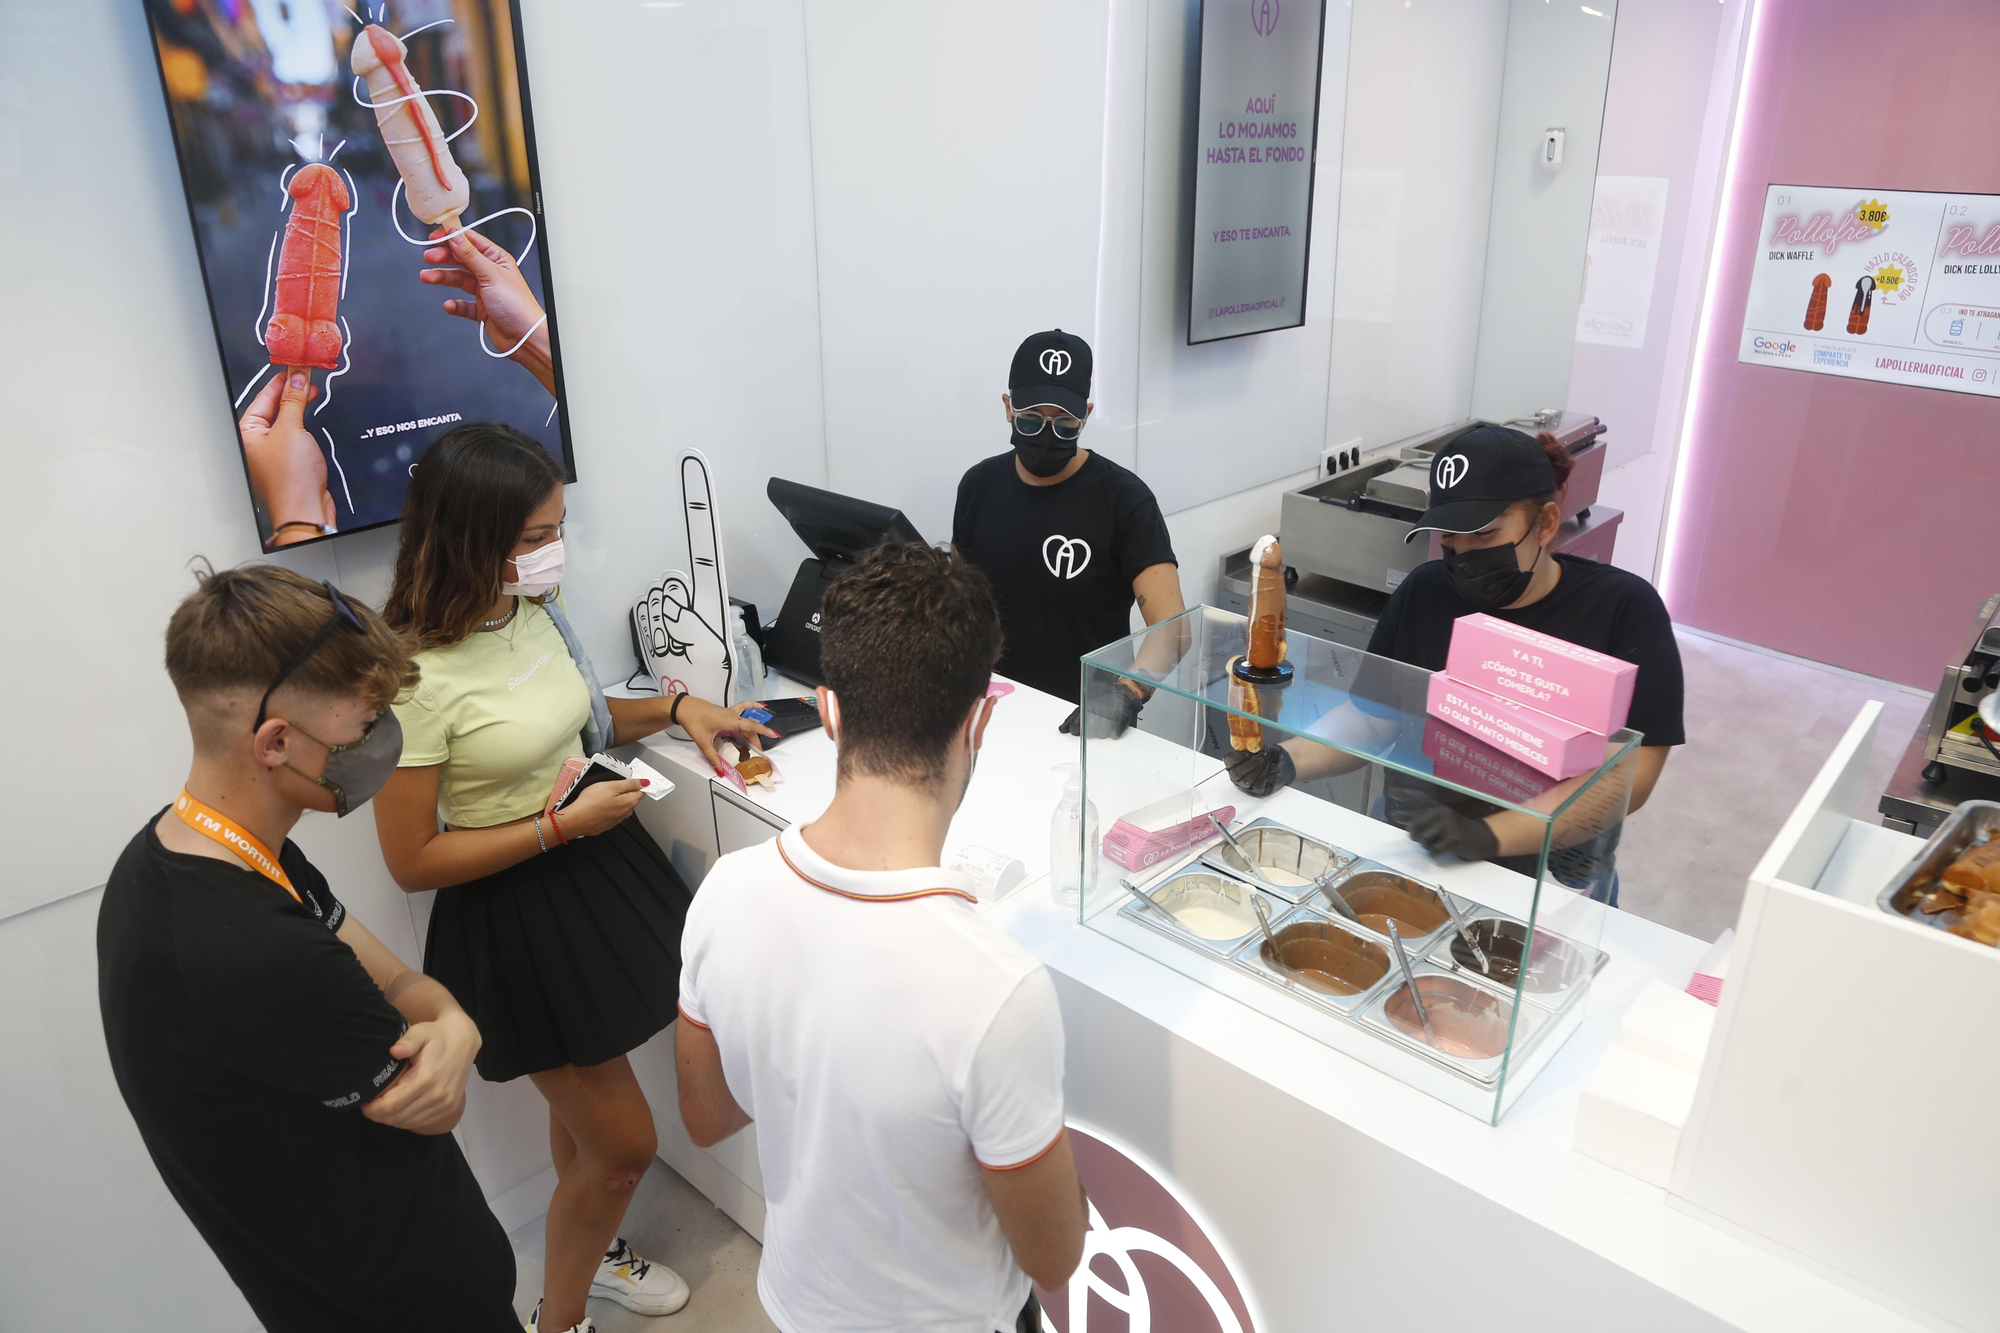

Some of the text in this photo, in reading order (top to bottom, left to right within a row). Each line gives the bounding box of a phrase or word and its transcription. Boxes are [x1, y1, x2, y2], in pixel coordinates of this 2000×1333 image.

[1245, 94, 1276, 114] AQUÍ
[1219, 122, 1296, 139] LO MOJAMOS
[1206, 146, 1305, 164] HASTA EL FONDO
[1859, 210, 1887, 222] 3.80€
[1213, 226, 1292, 243] Y ESO TE ENCANTA.
[1768, 251, 1814, 260] DICK WAFFLE
[1863, 252, 1918, 301] HAZLO CREMOSO POR
[1944, 264, 1963, 274] DICK
[1964, 264, 1978, 274] ICE
[1876, 276, 1899, 285] +0.50€
[1754, 336, 1796, 353] Google
[1813, 349, 1844, 360] COMPARTE
[1813, 357, 1849, 368] EXPERIENCIA
[1876, 357, 1965, 379] LAPOLLERIAOFICIAL
[375, 425, 395, 436] ESO
[396, 421, 417, 432] NOS
[417, 412, 462, 428] ENCANTA
[1512, 649, 1544, 668] Y A TI,
[1481, 660, 1570, 697] ¿CÓMO TE GUSTA
[1497, 676, 1551, 702] COMERLA?
[1446, 693, 1470, 711] ESTA
[1471, 705, 1496, 724] CAJA
[1496, 718, 1544, 748] CONTIENE
[1438, 703, 1549, 766] LO QUE TANTO MERECES
[194, 812, 281, 878] I'M WORTH IT
[372, 1059, 399, 1087] REAL
